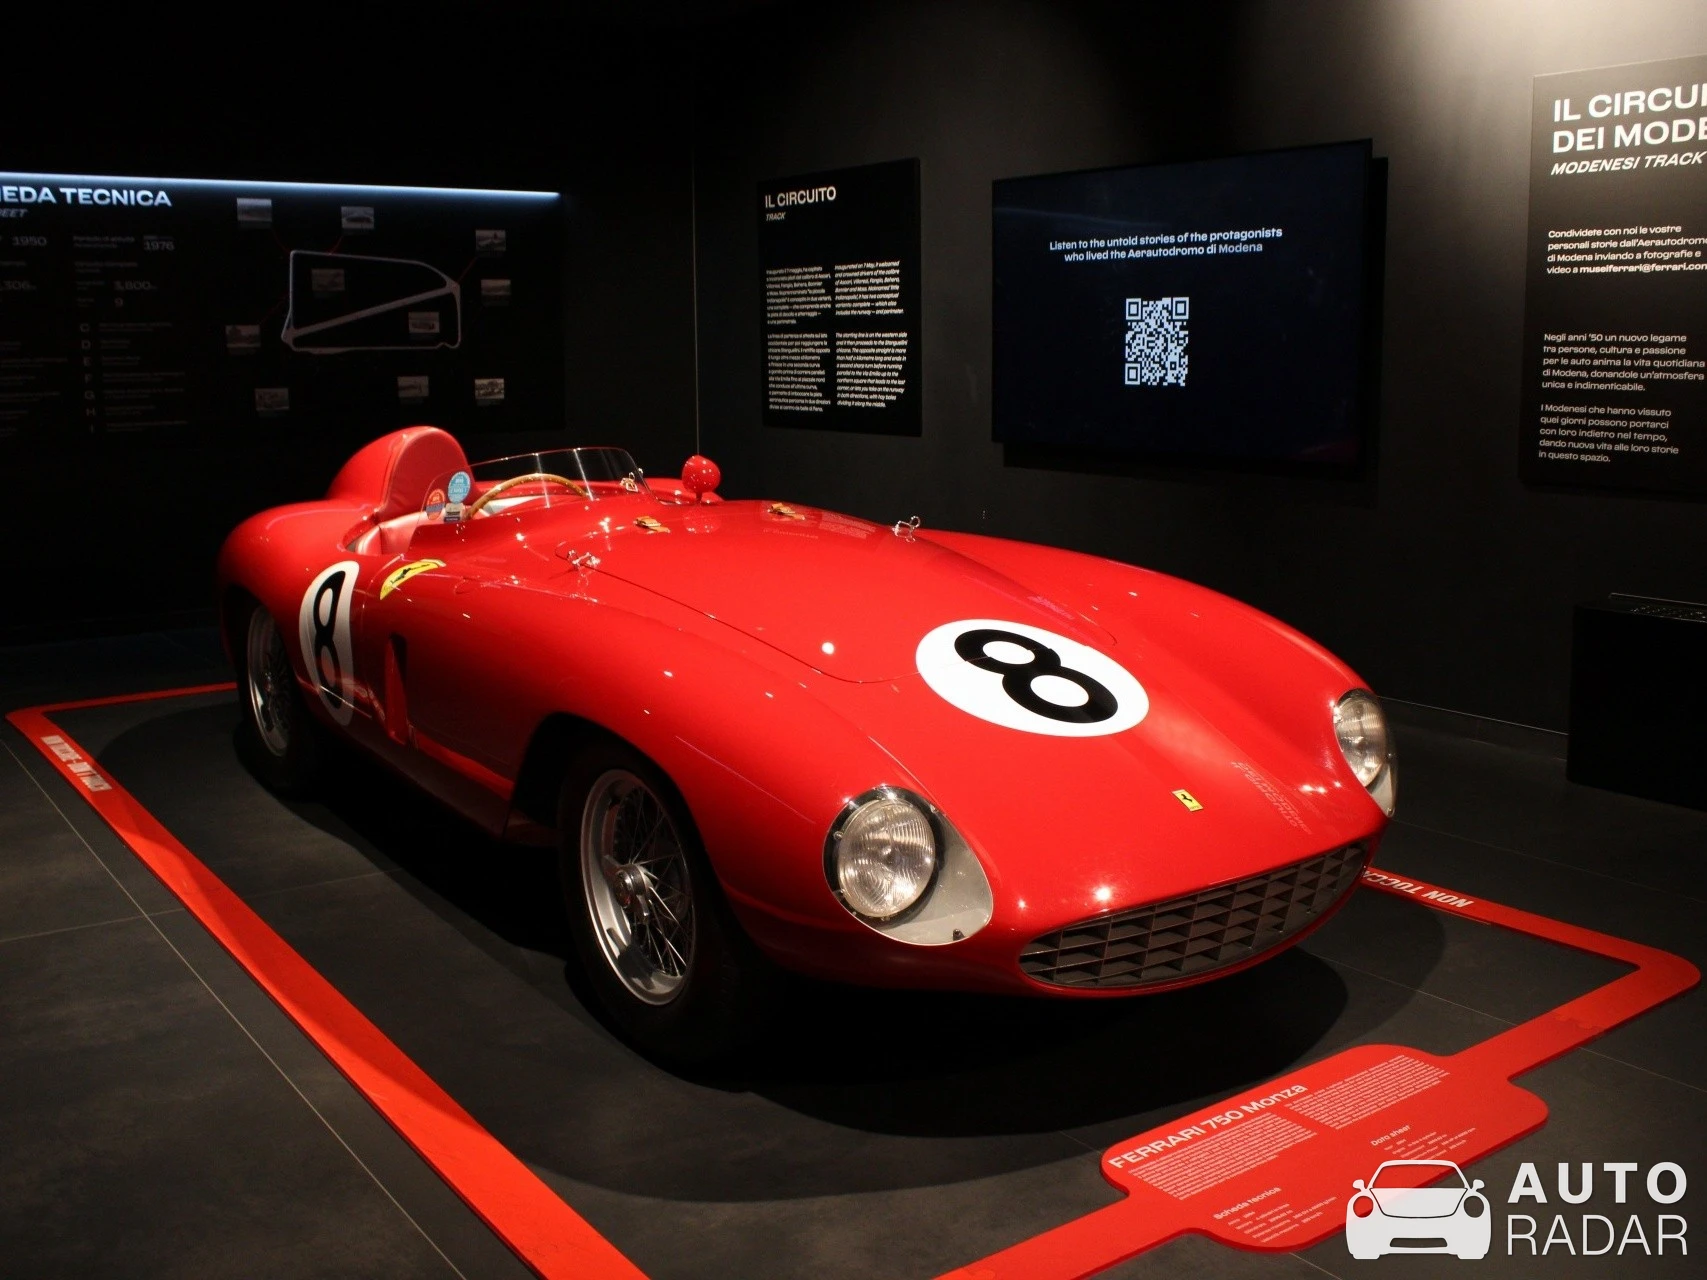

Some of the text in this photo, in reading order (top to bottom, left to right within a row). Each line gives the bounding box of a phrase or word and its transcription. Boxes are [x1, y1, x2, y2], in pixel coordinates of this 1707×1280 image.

[1554, 99, 1581, 122] IL
[1553, 127, 1605, 153] DEI
[1551, 150, 1707, 175] MODENESI TRACK
[0, 186, 172, 207] EDA TECNICA
[765, 186, 836, 208] IL CIRCUITO
[766, 212, 786, 221] TRACK
[1050, 227, 1283, 250] Listen to the untold stories of the protagonists
[1548, 229, 1602, 238] Condividete
[1623, 226, 1638, 235] noi
[1639, 226, 1648, 234] le
[1649, 225, 1681, 234] vostre
[1548, 240, 1589, 251] personali
[1591, 239, 1618, 249] storie
[1064, 243, 1262, 262] who lived the Aerautodromo di Modena
[1547, 254, 1555, 262] di
[1557, 253, 1593, 262] Modena
[1595, 252, 1634, 261] inviando
[1643, 250, 1693, 261] fotografie
[1547, 266, 1571, 274] video
[1544, 333, 1566, 343] Negli
[1568, 333, 1587, 342] anni
[1650, 334, 1687, 343] legame
[1543, 345, 1557, 353] tra
[1558, 346, 1598, 354] persone,
[1599, 346, 1633, 354] cultura
[1643, 346, 1686, 355] passione
[1543, 358, 1559, 366] per
[1561, 357, 1568, 365] le
[1593, 358, 1621, 366] anima
[1623, 358, 1631, 367] la
[1633, 358, 1651, 367] vita
[1653, 359, 1705, 368] quotidiana
[1542, 369, 1704, 381] di Modena, donandole un'atmosfera
[1542, 381, 1565, 389] unica
[1575, 381, 1646, 391] indimenticabile.
[1545, 404, 1587, 413] Modenesi
[1589, 406, 1605, 414] che
[1607, 406, 1636, 415] hanno
[1638, 407, 1671, 417] vissuto
[1540, 416, 1669, 429] quei giorni possono portarci
[1558, 428, 1577, 437] loro
[1579, 429, 1615, 439] indietro
[1617, 431, 1631, 440] nel
[1633, 432, 1668, 442] tempo,
[1539, 439, 1679, 454] dando nuova vita alle loro storie
[1539, 450, 1611, 463] in questo spazio.
[313, 571, 346, 709] 8
[954, 629, 1118, 724] 8
[1421, 890, 1474, 908] NON
[1108, 1126, 1207, 1169] FERRARI
[1200, 1110, 1245, 1130] 750
[1240, 1084, 1308, 1114] Monza
[1370, 1125, 1411, 1147] Data sheet
[1212, 1187, 1282, 1220] Scheda tecnica
